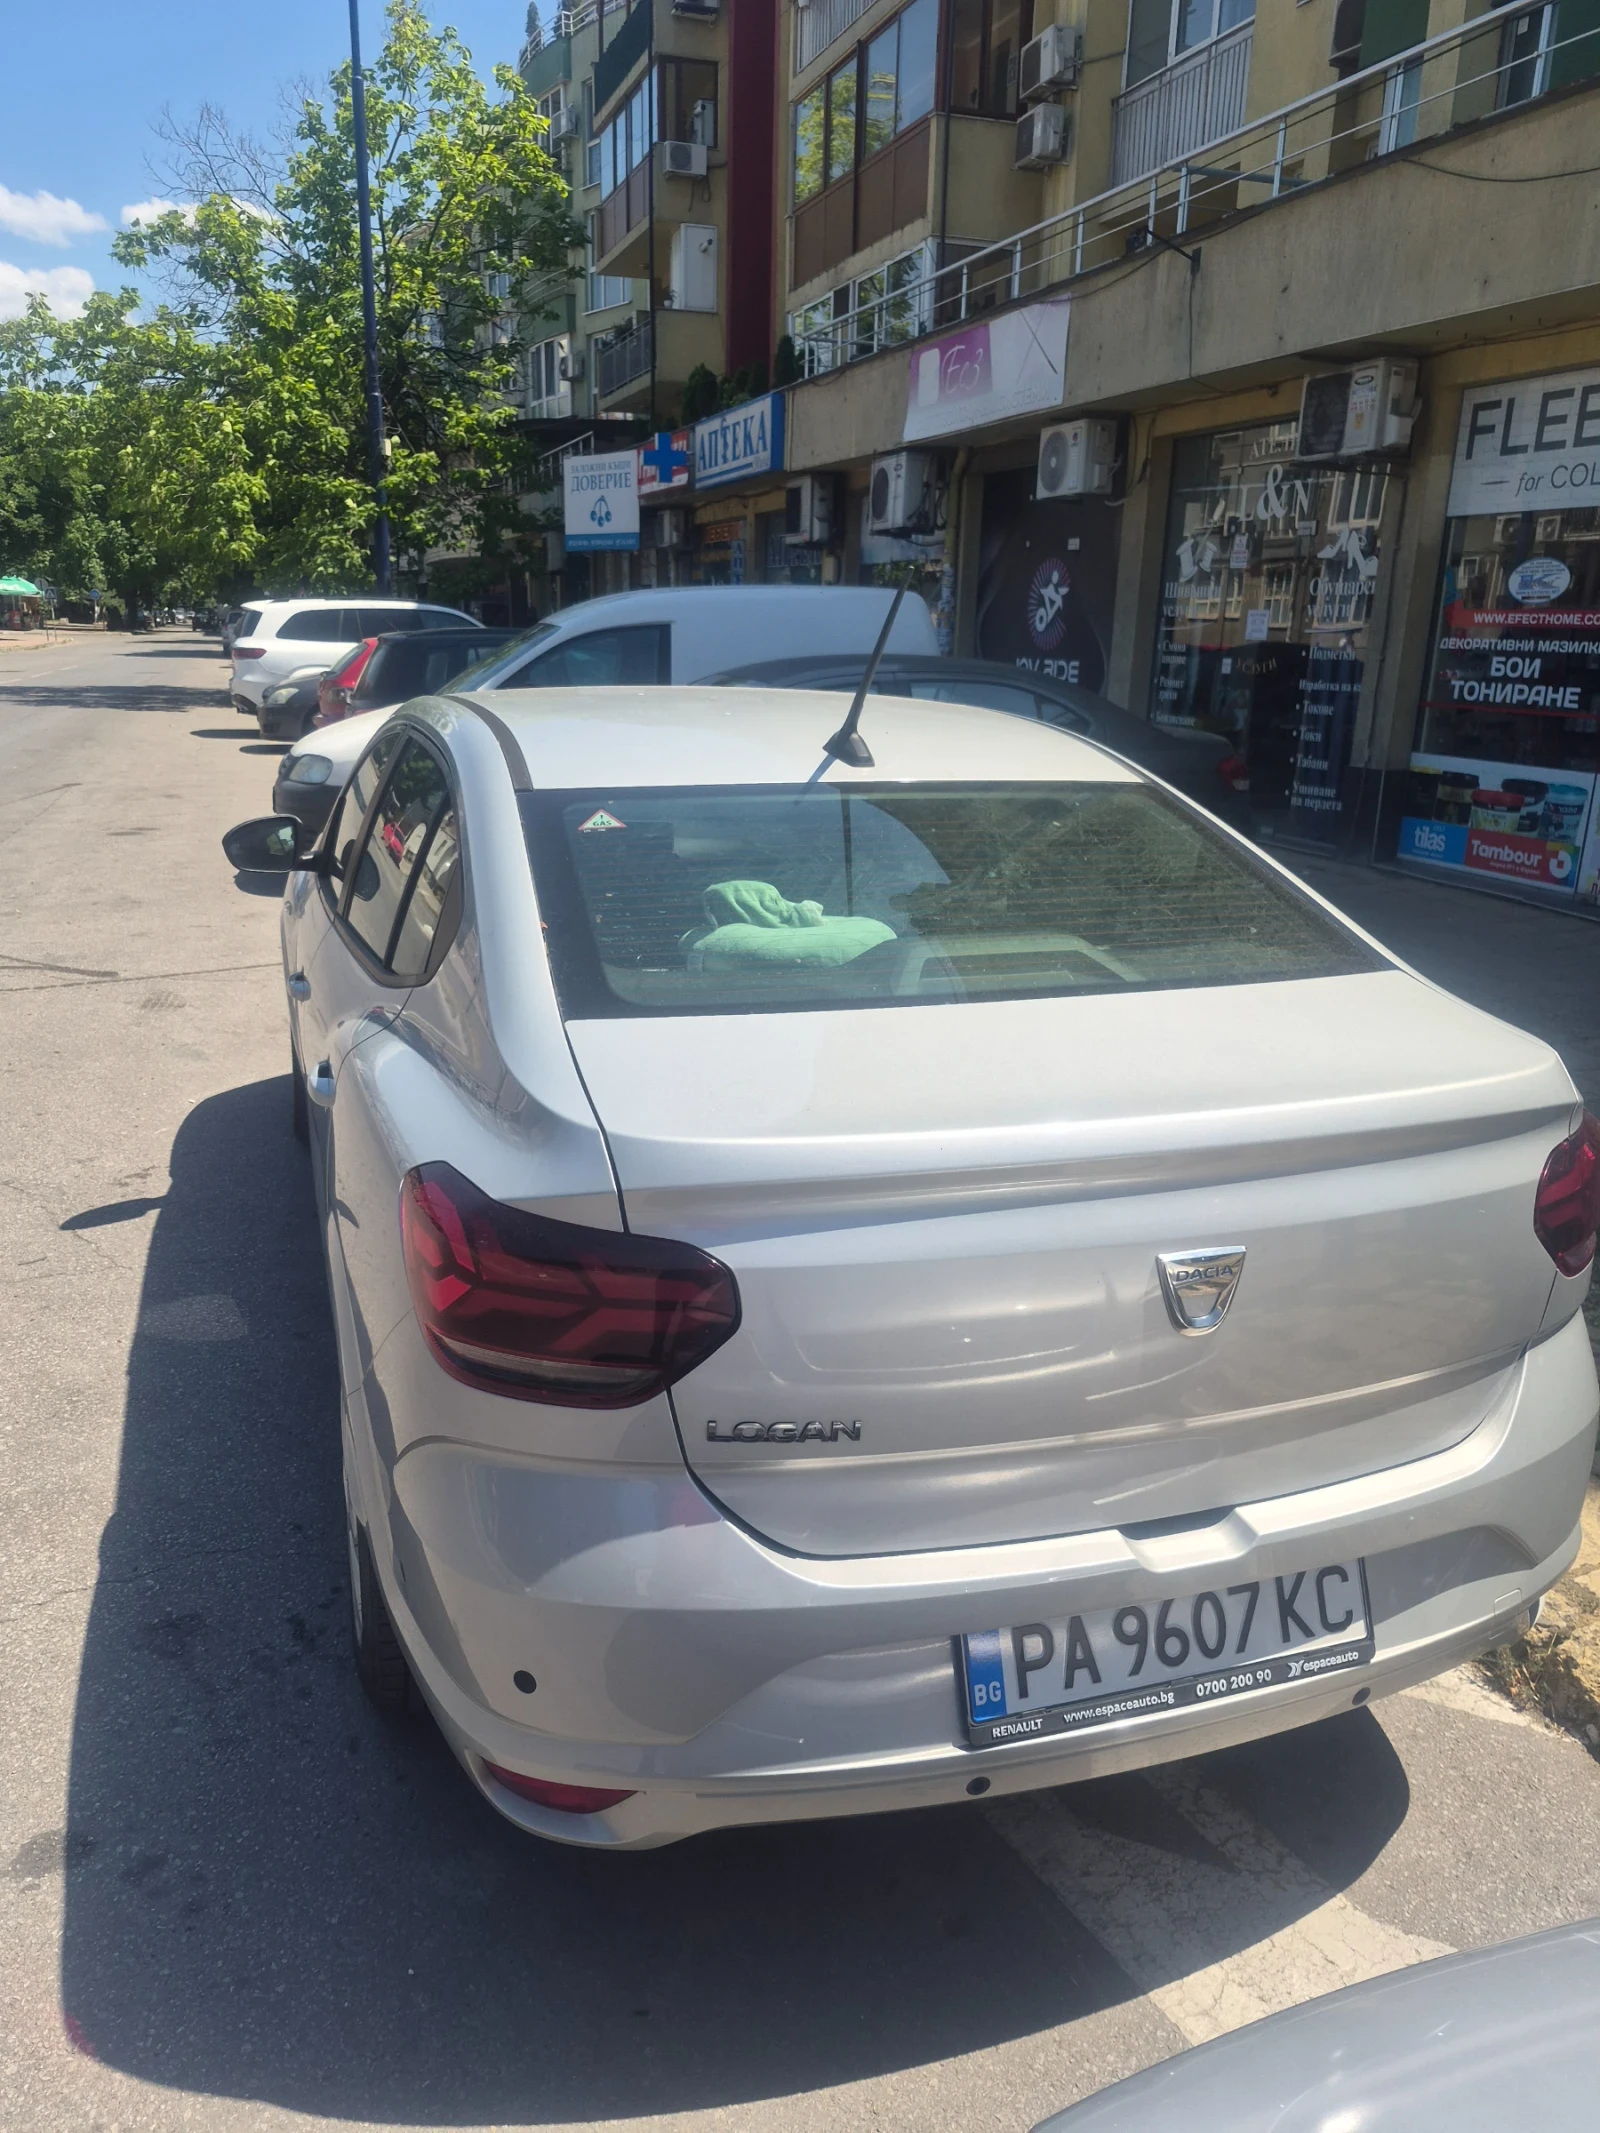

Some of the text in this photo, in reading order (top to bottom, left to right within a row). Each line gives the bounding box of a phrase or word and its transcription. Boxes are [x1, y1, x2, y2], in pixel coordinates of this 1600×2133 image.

[697, 410, 768, 473] АПТЕКА
[1250, 437, 1295, 460] АТЕЛИ
[571, 472, 632, 494] ДОВЕРИЕ
[1515, 461, 1600, 497] for COL
[1439, 637, 1600, 654] ДЕКОРАТИВНИ МАЗИЛК
[1044, 659, 1080, 684] RIDE
[1490, 656, 1541, 679] БОИ
[1451, 680, 1581, 709] ТОНИРАНЕ
[1302, 700, 1334, 716] Токове
[1300, 727, 1322, 743] Токи
[1296, 754, 1328, 771] Табани
[1414, 825, 1447, 853] tilas
[1471, 839, 1543, 868] Tambour
[1175, 1265, 1233, 1282] DACIA
[706, 1419, 863, 1444] LOGAN
[1012, 1565, 1354, 1699] PA 9607 KC
[974, 1681, 1002, 1706] BG
[992, 1650, 1359, 1738] RENAULT www.espaceauto.bg 0700 200 90 espaceauto
